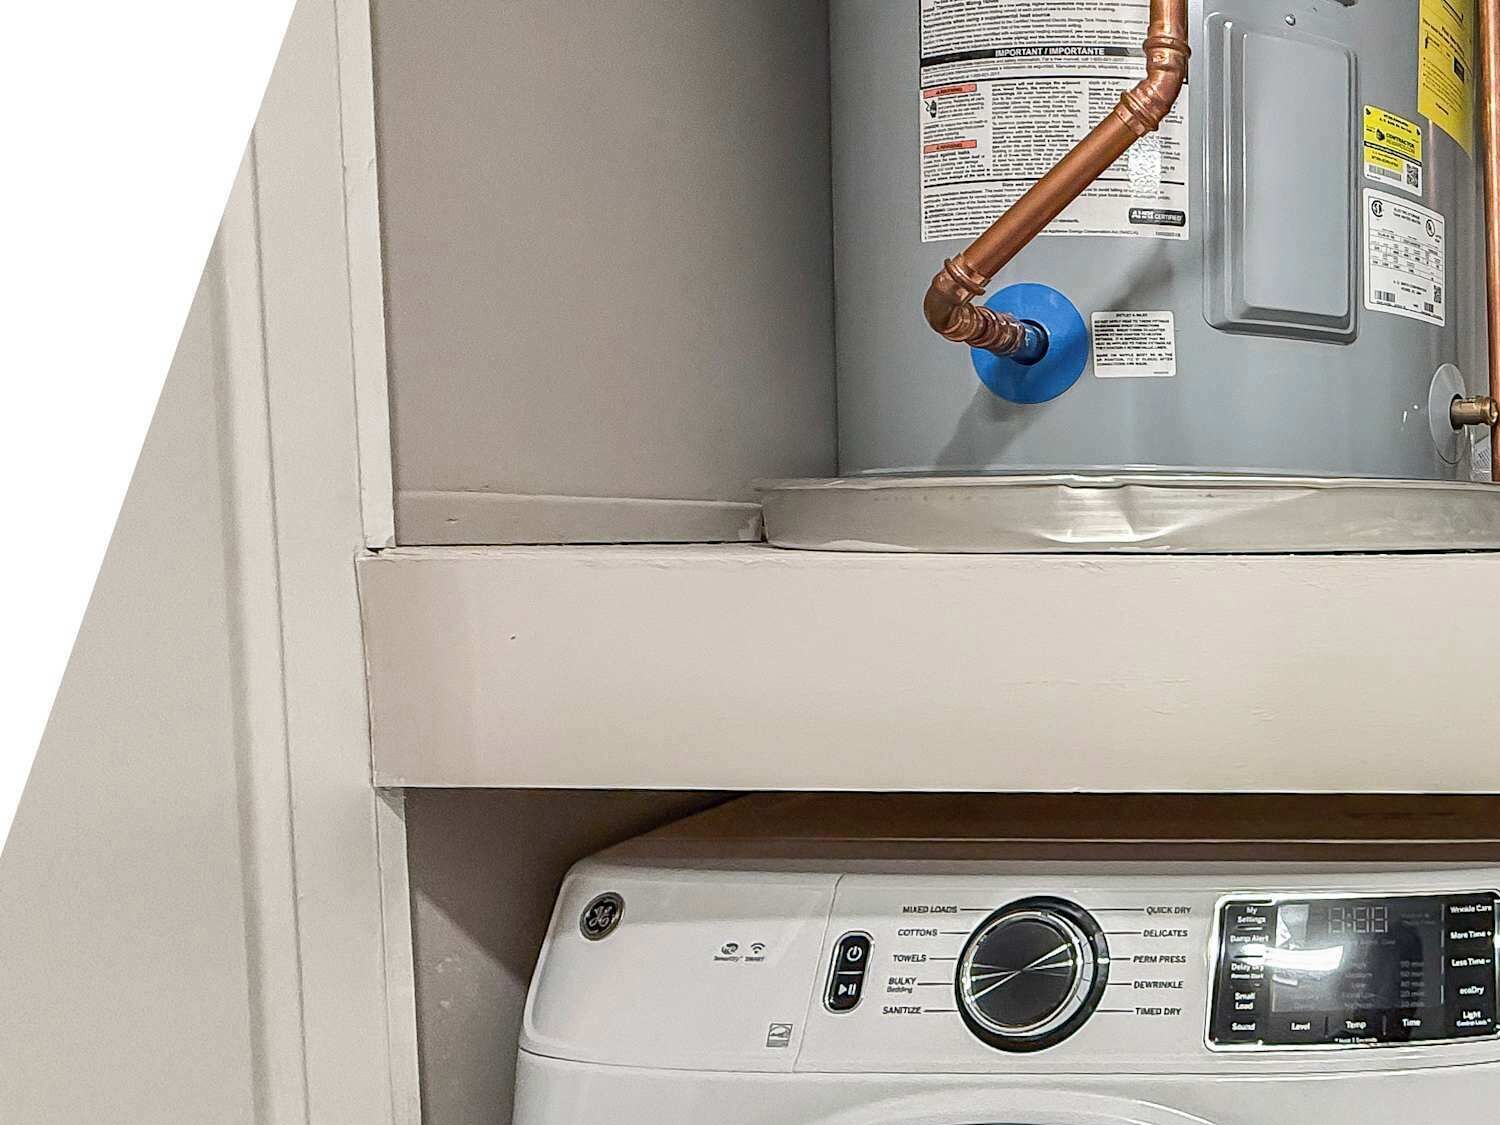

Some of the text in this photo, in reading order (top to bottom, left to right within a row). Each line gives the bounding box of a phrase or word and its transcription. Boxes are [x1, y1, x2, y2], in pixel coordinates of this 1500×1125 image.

[995, 48, 1043, 58] IMPORTANT
[1049, 47, 1105, 56] IMPORTANTE
[902, 906, 929, 914] MIXED
[1146, 906, 1173, 915] QUICK
[1246, 907, 1258, 915] My
[1450, 904, 1492, 913] Wrinkle Care
[1237, 916, 1266, 924] Settings
[898, 929, 938, 937] COTTONS
[1143, 929, 1188, 937] DELICATES
[1450, 931, 1468, 939] More
[1230, 935, 1251, 943] Damp
[893, 954, 927, 962] TOWELS
[1133, 955, 1187, 963] PERM PRESS
[1451, 959, 1468, 967] Less
[1468, 958, 1485, 966] Time
[1231, 963, 1251, 972] Delay
[888, 977, 917, 985] BULKY
[1134, 981, 1184, 989] DEWRINKLE
[1459, 986, 1485, 995] ecoDry
[1235, 992, 1256, 1000] Small
[882, 1006, 922, 1014] SANITIZE
[1235, 1002, 1254, 1010] Load
[1135, 1007, 1182, 1015] TIMED DRY
[1463, 1011, 1482, 1019] Light
[1232, 1022, 1256, 1031] Sound
[1291, 1022, 1311, 1031] Level
[1345, 1020, 1367, 1029] Temp
[1402, 1018, 1421, 1027] Time
